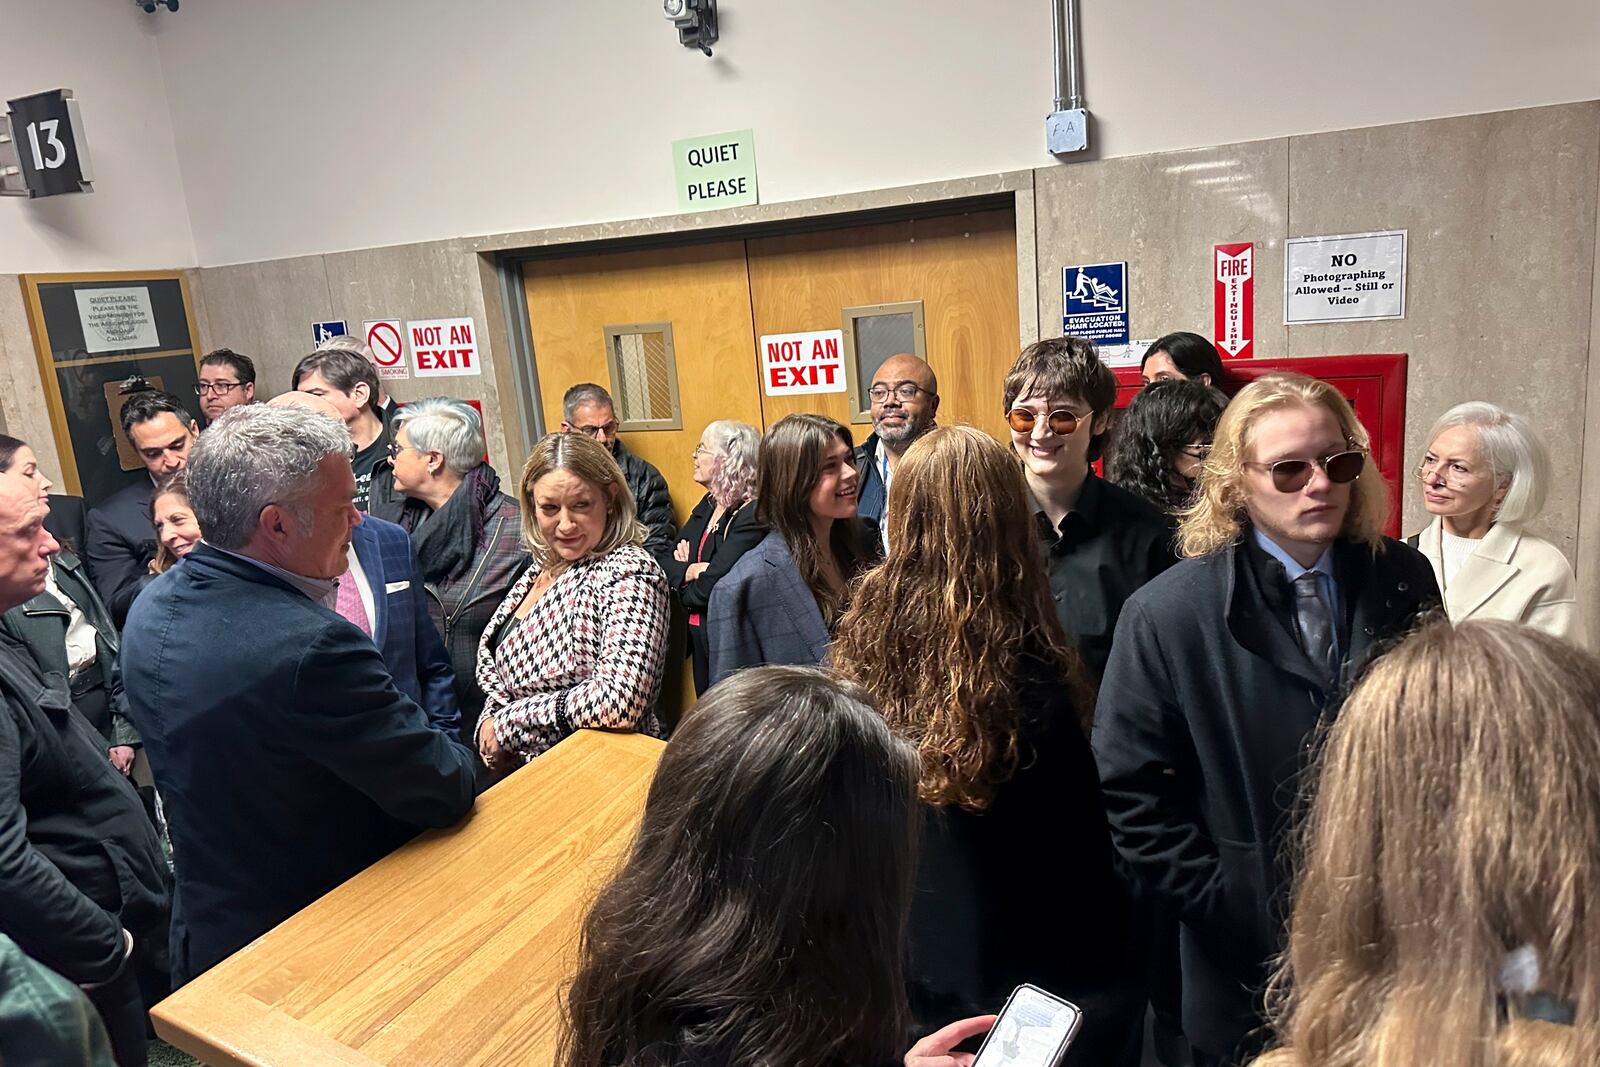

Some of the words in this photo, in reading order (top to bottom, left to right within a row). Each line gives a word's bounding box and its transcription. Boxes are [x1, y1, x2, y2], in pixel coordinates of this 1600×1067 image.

[27, 119, 66, 170] 13
[688, 143, 739, 167] QUIET
[688, 177, 746, 200] PLEASE
[1221, 259, 1247, 276] FIRE
[1331, 254, 1357, 267] NO
[1303, 270, 1386, 282] Photographing
[1295, 284, 1340, 295] Allowed
[1355, 282, 1378, 291] Still
[1328, 296, 1359, 305] Video
[1069, 315, 1120, 324] EVACUATION
[413, 327, 441, 346] NOT
[450, 325, 472, 344] AN
[416, 349, 473, 369] EXIT
[767, 341, 802, 362] NOT
[812, 338, 838, 360] AN
[770, 364, 839, 387] EXIT
